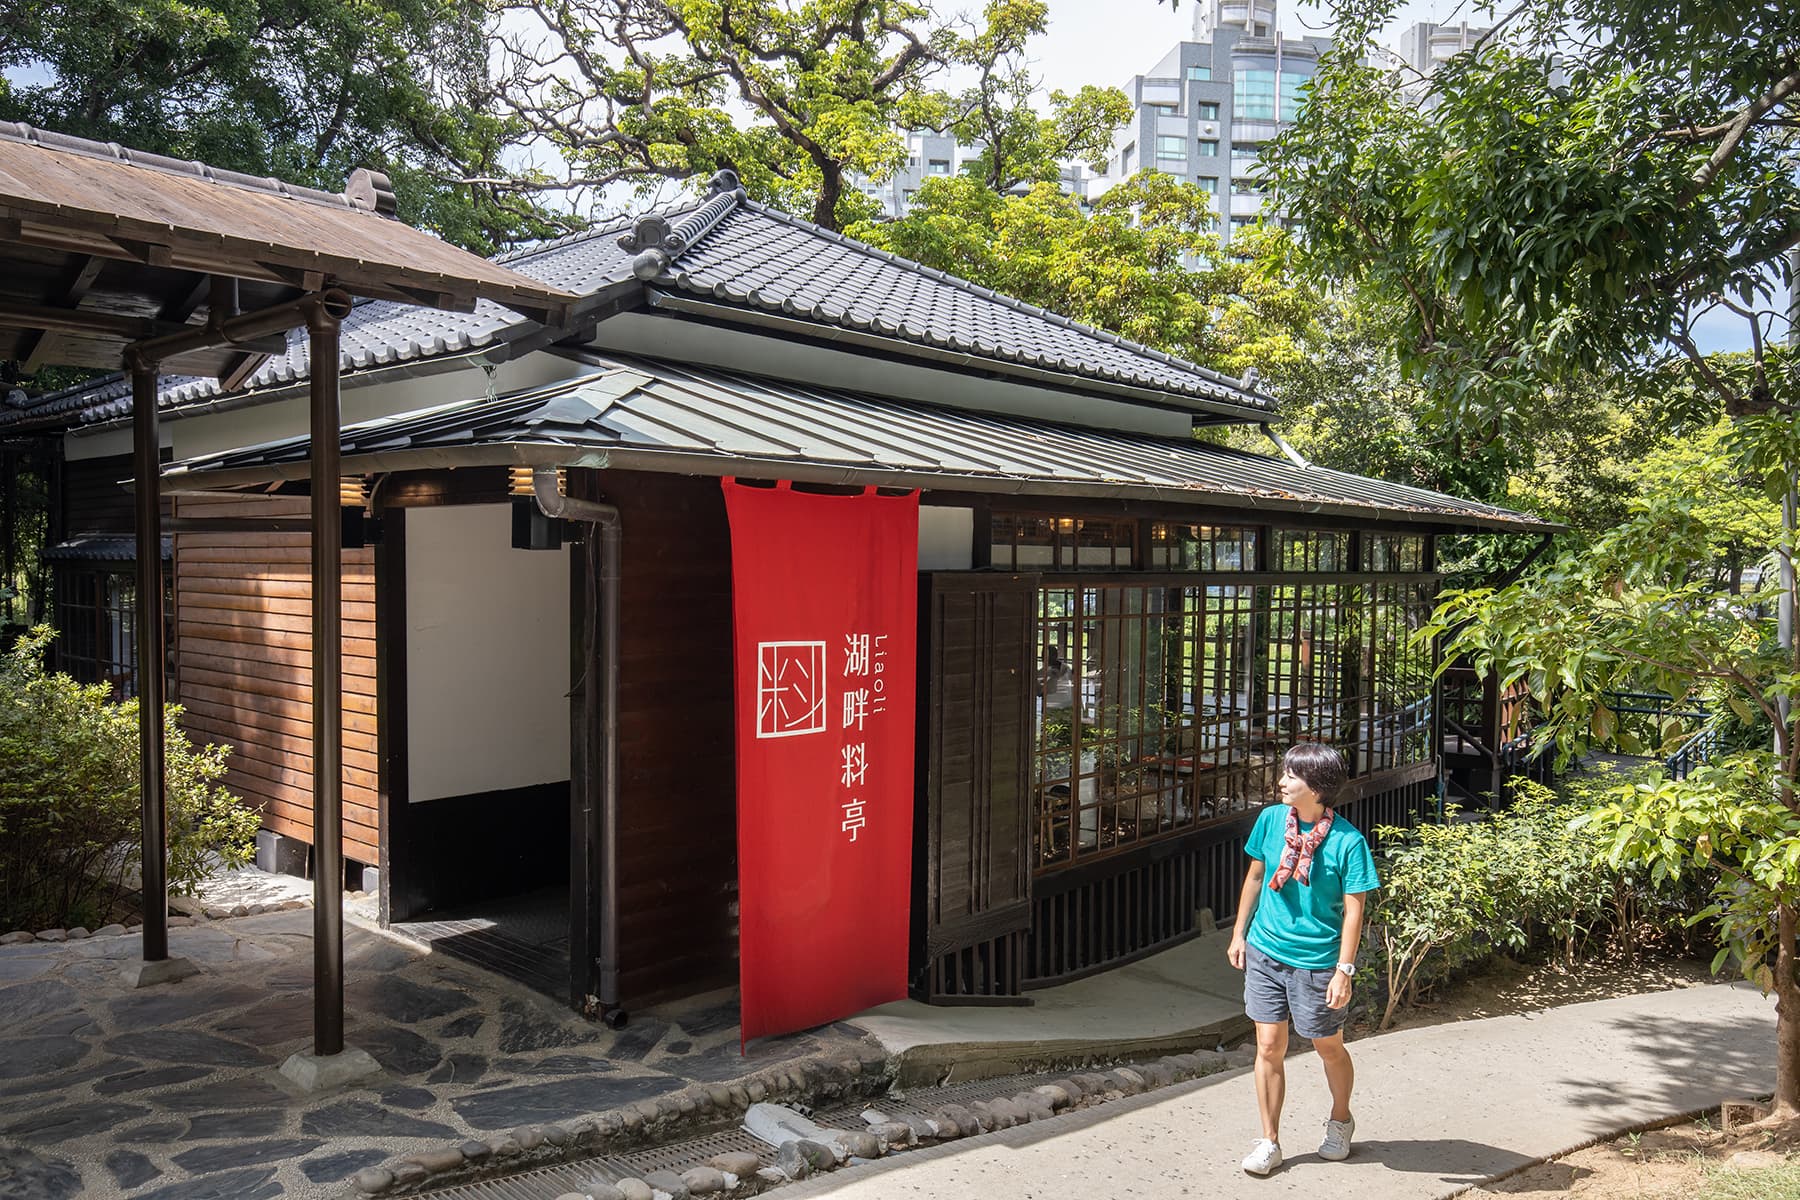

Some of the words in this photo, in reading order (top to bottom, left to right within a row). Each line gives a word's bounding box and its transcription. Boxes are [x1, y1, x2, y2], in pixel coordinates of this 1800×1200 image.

[840, 633, 870, 842] 湖畔料亭
[873, 634, 888, 714] Liaoli
